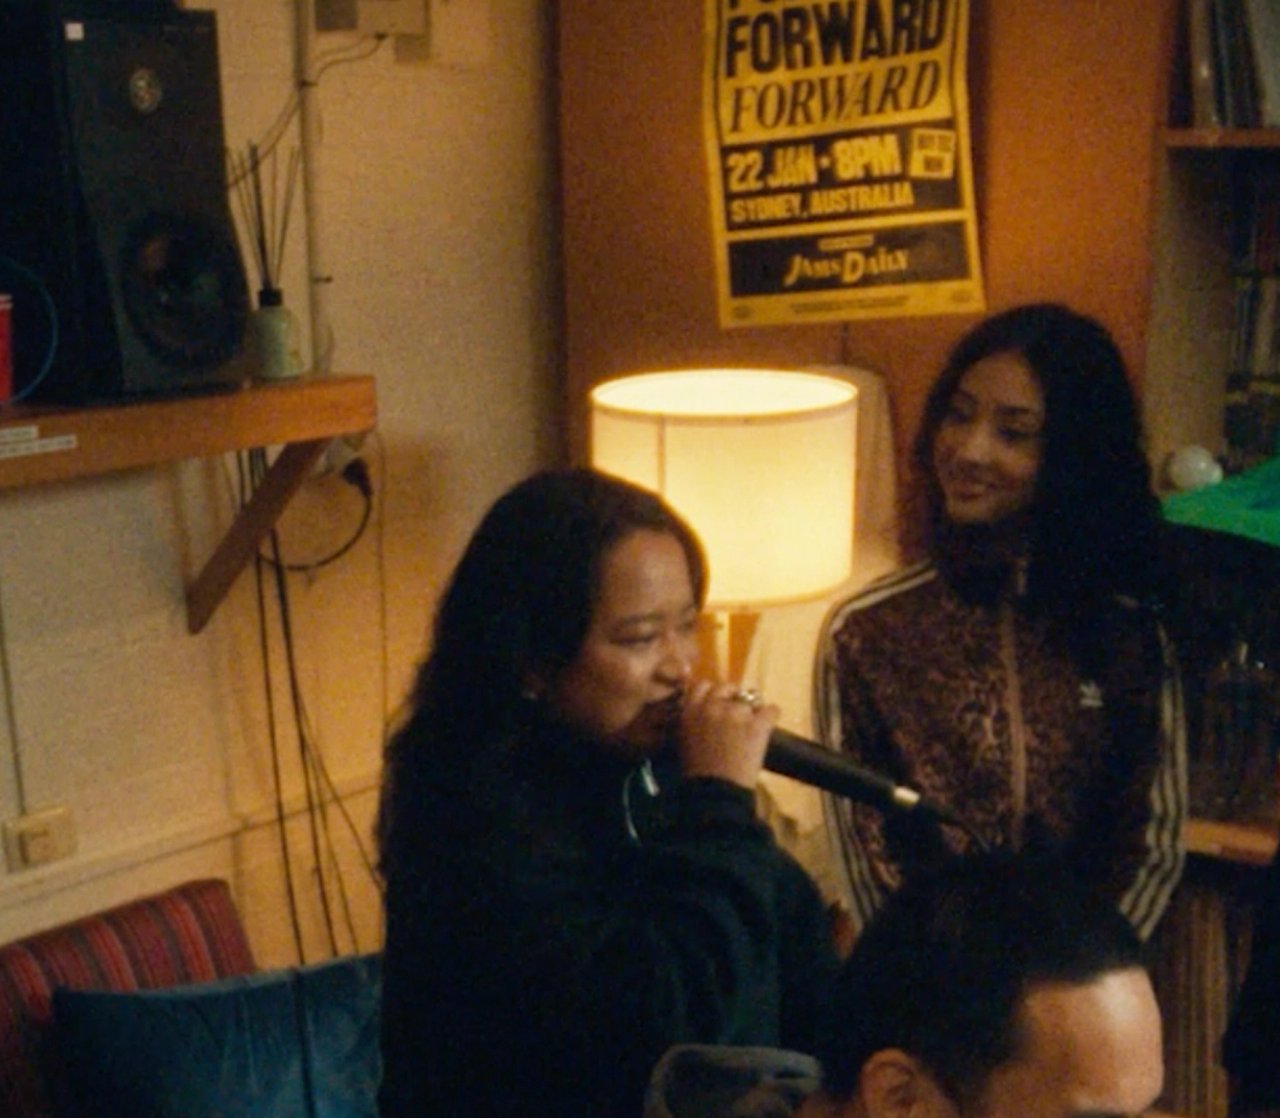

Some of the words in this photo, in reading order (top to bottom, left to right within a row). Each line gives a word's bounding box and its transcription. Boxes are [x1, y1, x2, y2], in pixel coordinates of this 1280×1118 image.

[725, 0, 950, 78] FORWARD
[730, 60, 940, 132] FORWARD
[727, 151, 764, 192] 22
[767, 144, 818, 188] JAN
[832, 134, 902, 180] 8PM
[810, 181, 915, 214] AUSTRALIA
